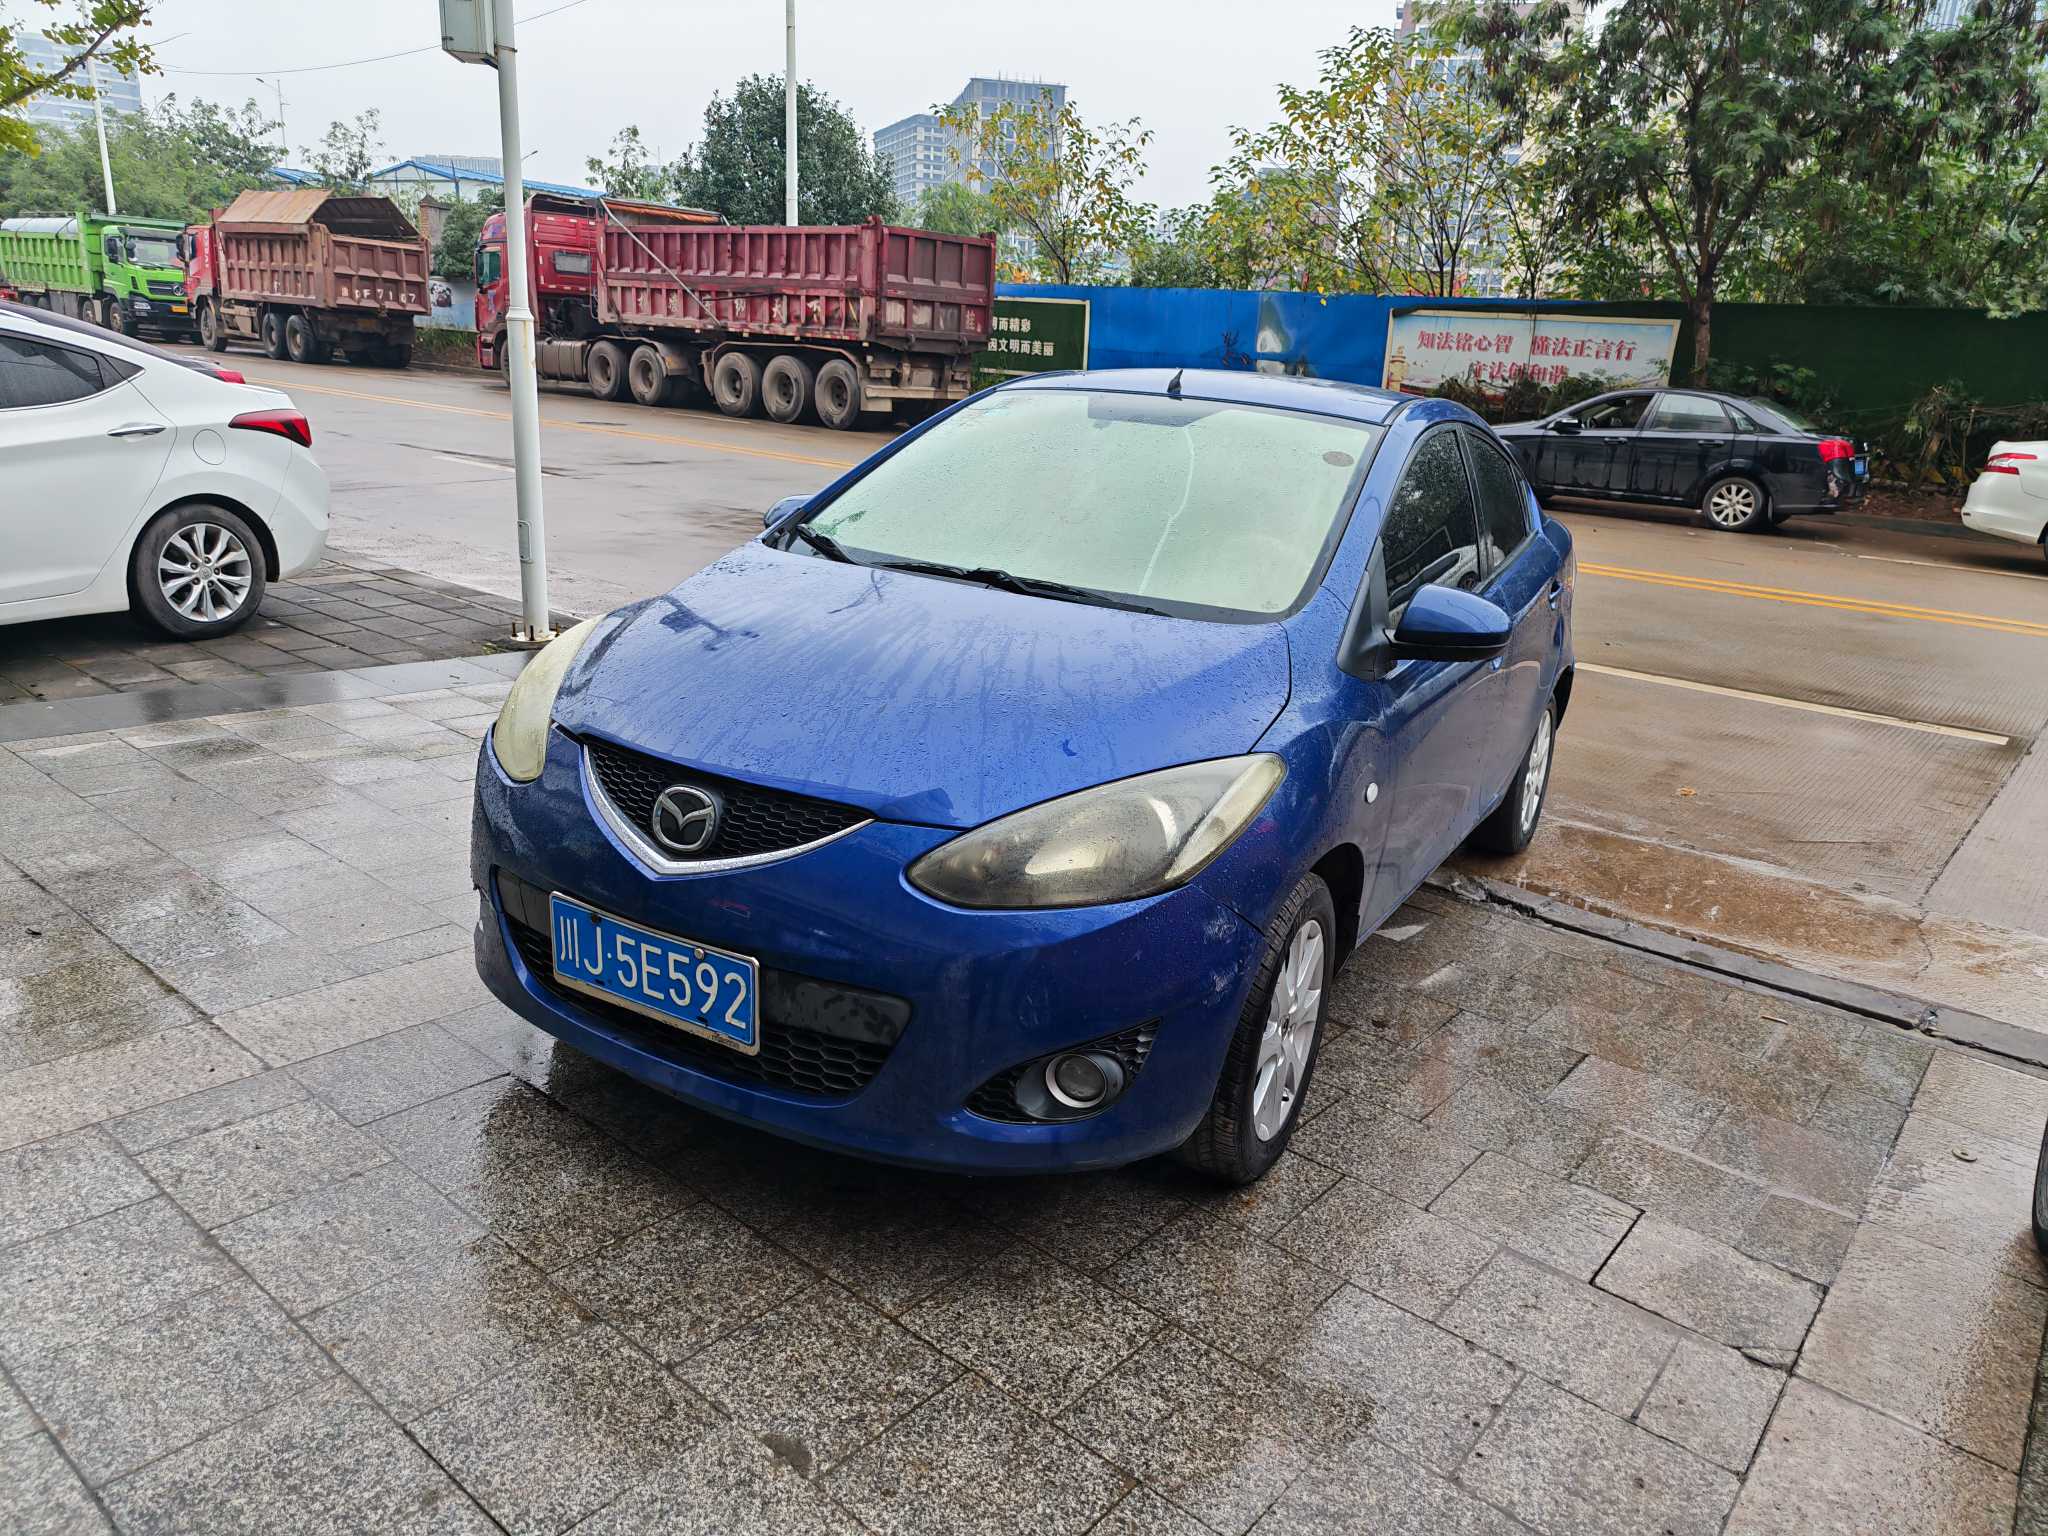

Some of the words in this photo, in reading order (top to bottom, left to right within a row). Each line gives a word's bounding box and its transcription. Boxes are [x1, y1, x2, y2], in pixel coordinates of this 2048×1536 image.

[988, 338, 1055, 356] 因文明而美丽
[1417, 329, 1514, 354] 知法铭心智
[1532, 335, 1637, 360] 懂法正言行
[559, 915, 747, 1030] 川J·5E592
